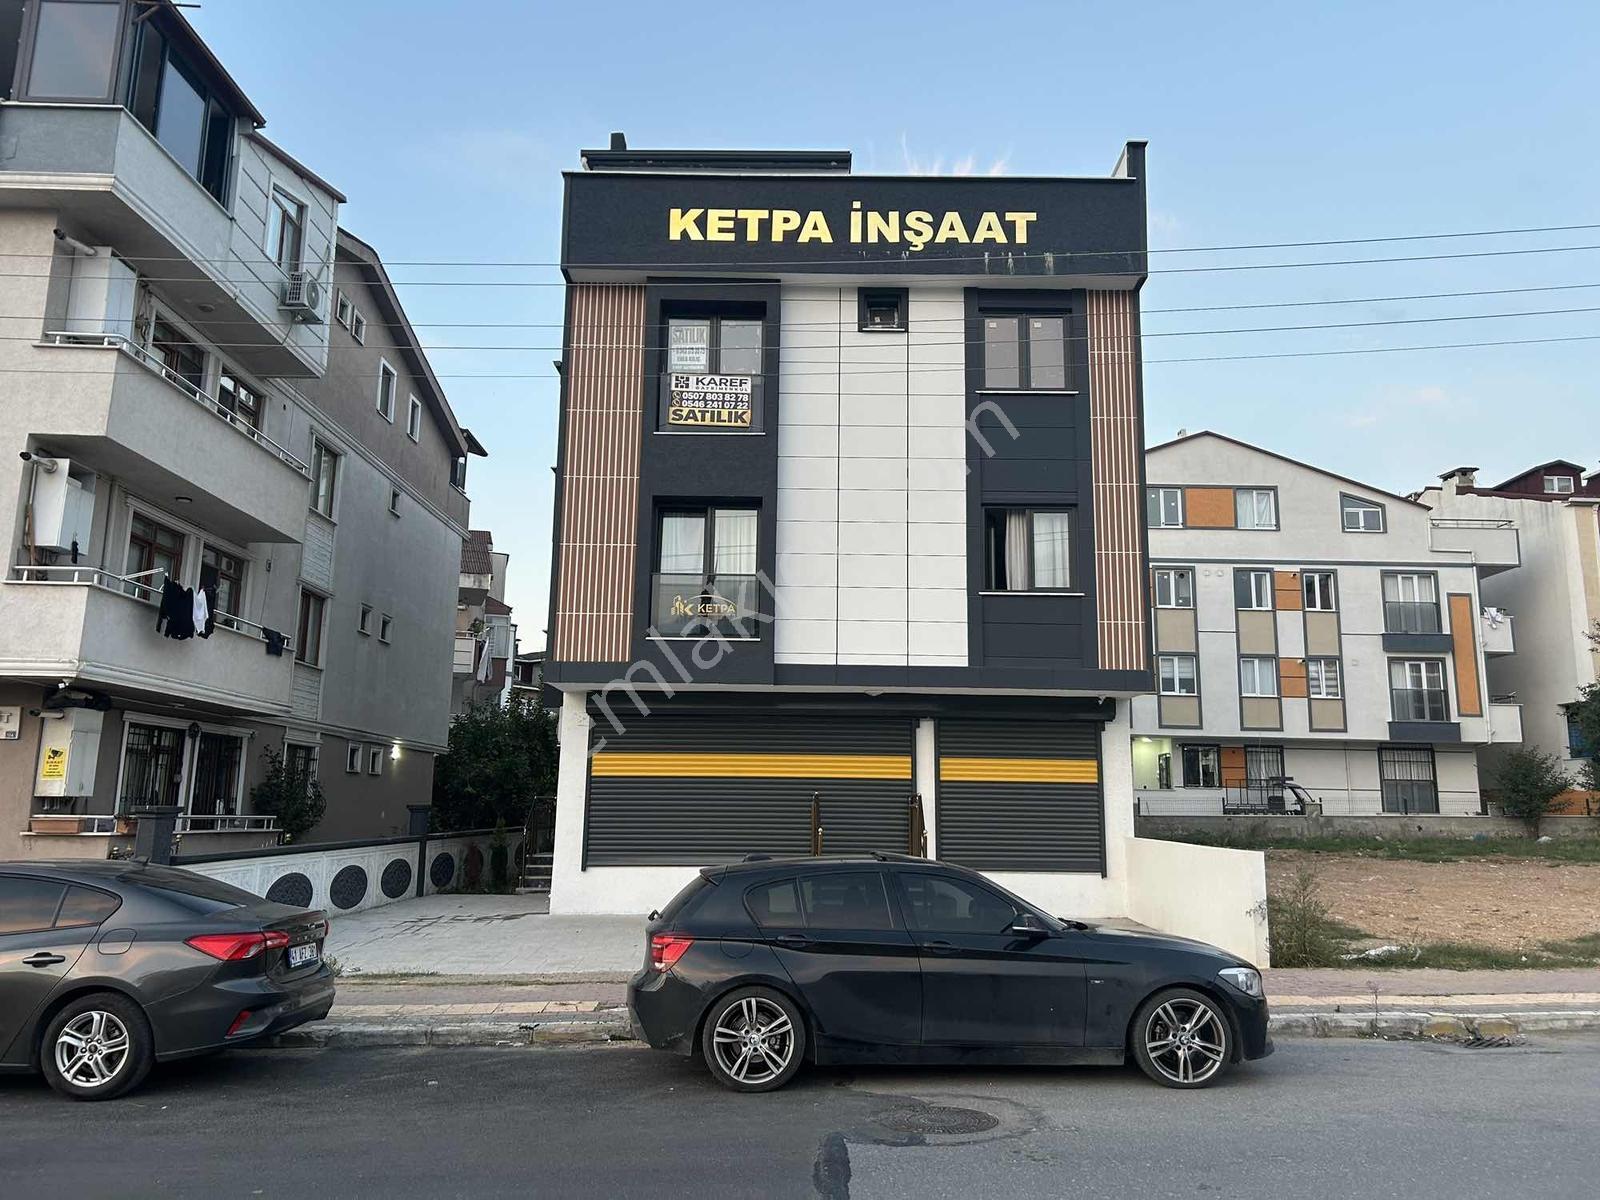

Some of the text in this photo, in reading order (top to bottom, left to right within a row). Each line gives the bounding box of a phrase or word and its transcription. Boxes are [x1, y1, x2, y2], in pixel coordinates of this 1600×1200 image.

[668, 201, 1037, 251] KETPA İNŞAAT
[695, 377, 749, 387] KAREF
[682, 392, 705, 400] 0507
[705, 393, 723, 401] 803
[737, 394, 749, 402] 78
[682, 400, 705, 408] 0546
[737, 402, 749, 410] 22
[671, 409, 749, 423] SATILIK
[697, 603, 736, 613] KETPA
